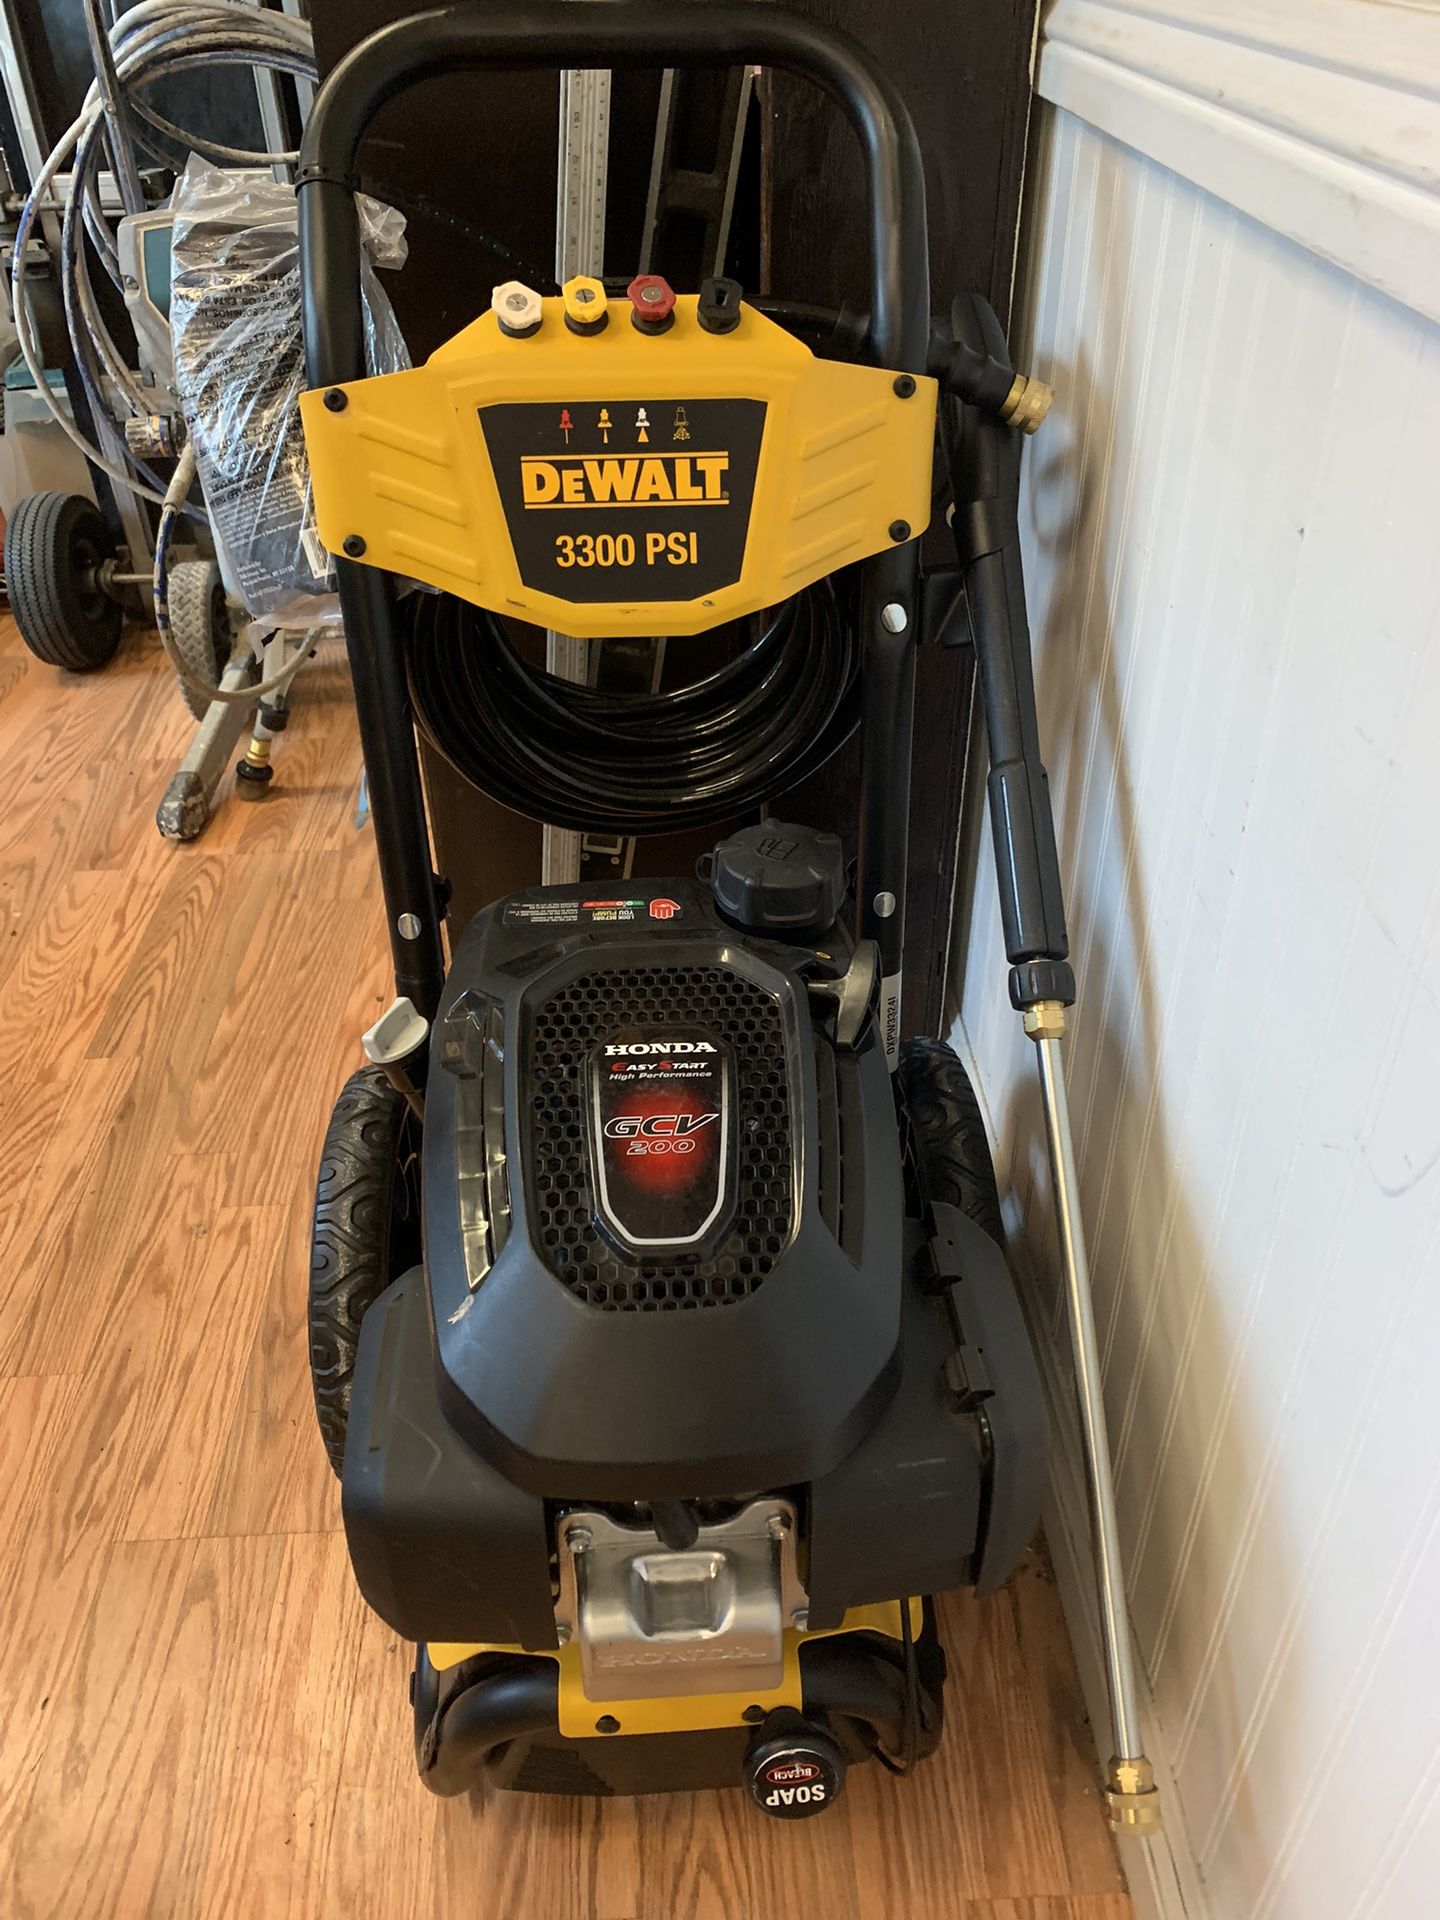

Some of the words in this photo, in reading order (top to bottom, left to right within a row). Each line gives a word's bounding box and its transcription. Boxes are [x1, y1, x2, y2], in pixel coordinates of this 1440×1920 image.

[555, 534, 635, 567] 3300
[646, 532, 698, 565] PSI
[604, 1042, 717, 1056] HONDA
[611, 1062, 657, 1072] EASY
[658, 1060, 708, 1071] START
[609, 1073, 635, 1082] High
[638, 1071, 712, 1080] Performance
[604, 1113, 720, 1139] GCV
[626, 1139, 695, 1155] 200
[597, 1646, 767, 1669] HONDA
[774, 1767, 812, 1781] BLEACH
[765, 1784, 825, 1806] SOAP
